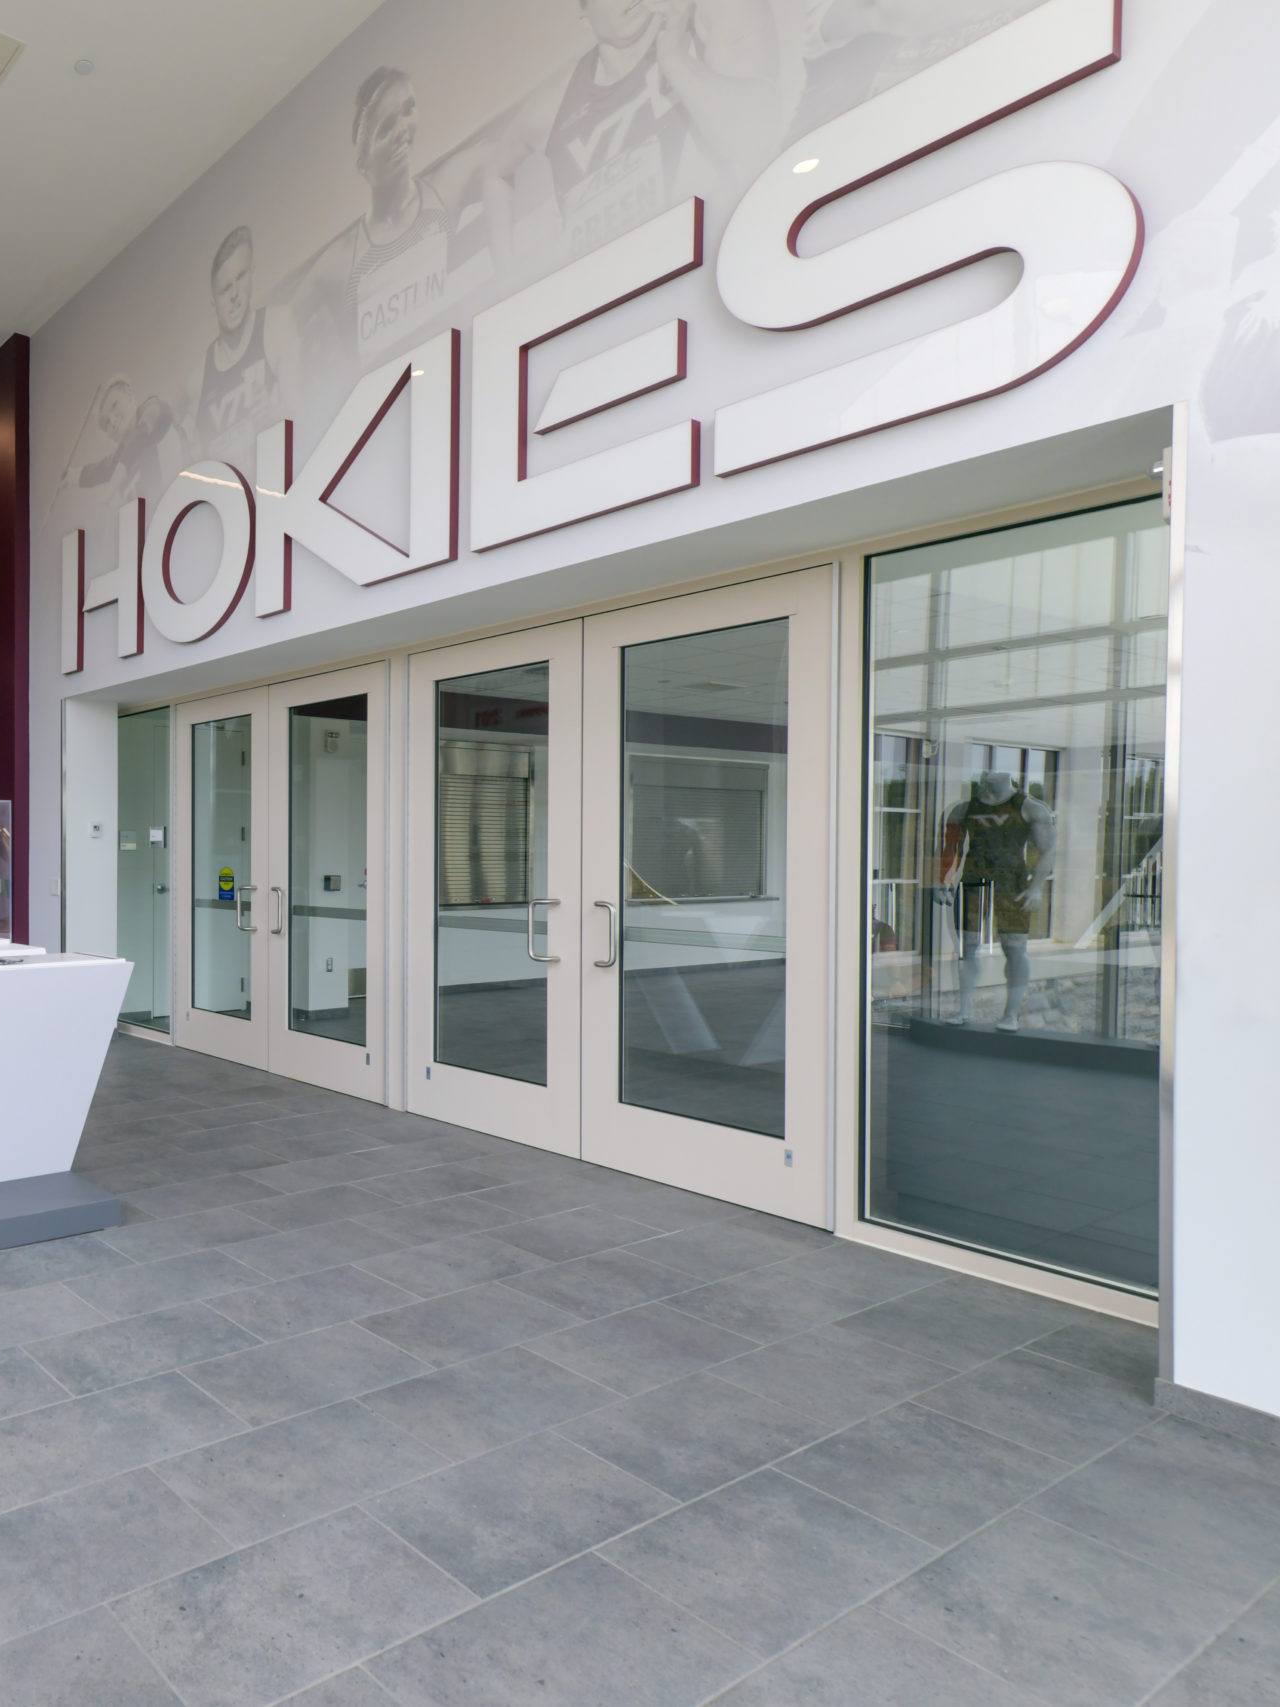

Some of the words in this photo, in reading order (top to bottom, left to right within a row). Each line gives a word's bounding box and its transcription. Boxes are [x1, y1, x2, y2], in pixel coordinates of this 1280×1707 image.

[570, 174, 658, 256] GREEN
[61, 0, 1145, 675] HOKIES
[360, 269, 446, 342] CASTLIN
